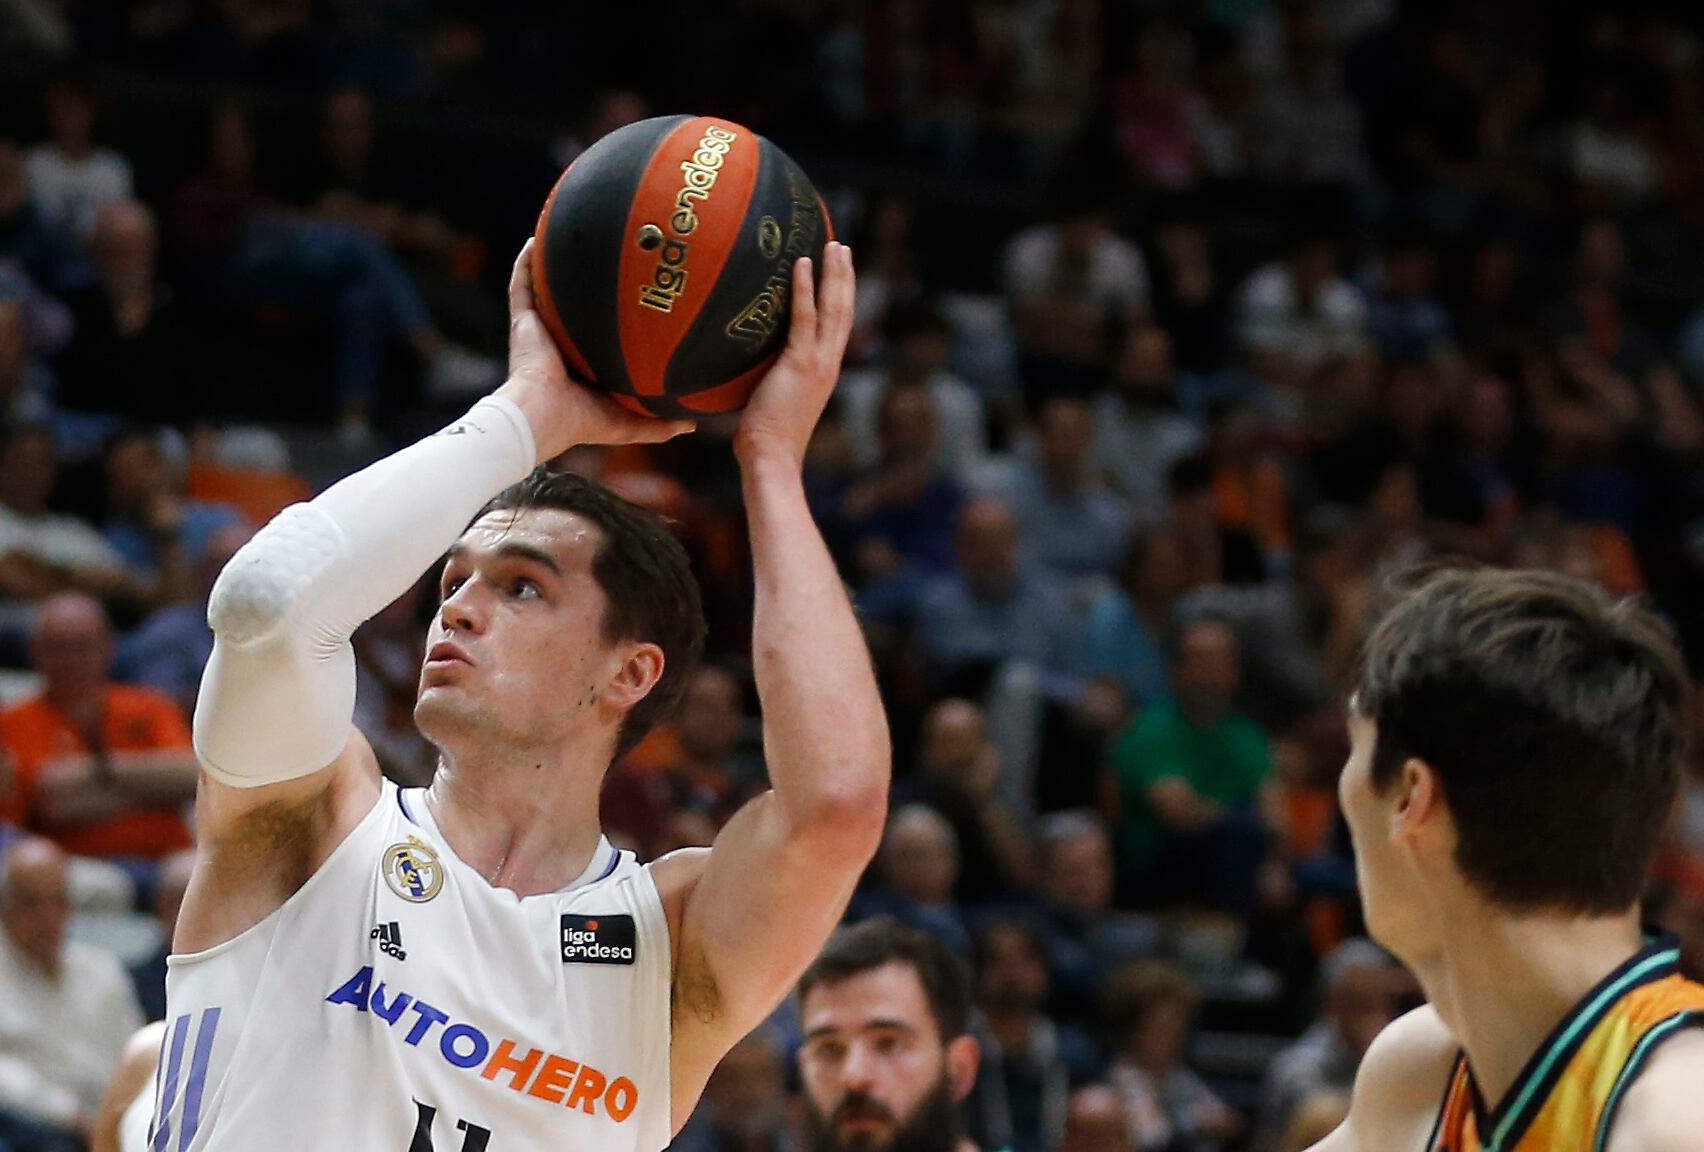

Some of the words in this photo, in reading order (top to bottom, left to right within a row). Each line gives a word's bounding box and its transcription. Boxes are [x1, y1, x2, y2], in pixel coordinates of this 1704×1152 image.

[639, 238, 690, 313] liga
[670, 125, 737, 236] endesa
[563, 928, 597, 945] liga
[563, 943, 633, 960] endesa
[326, 965, 638, 1123] AUTOHERO
